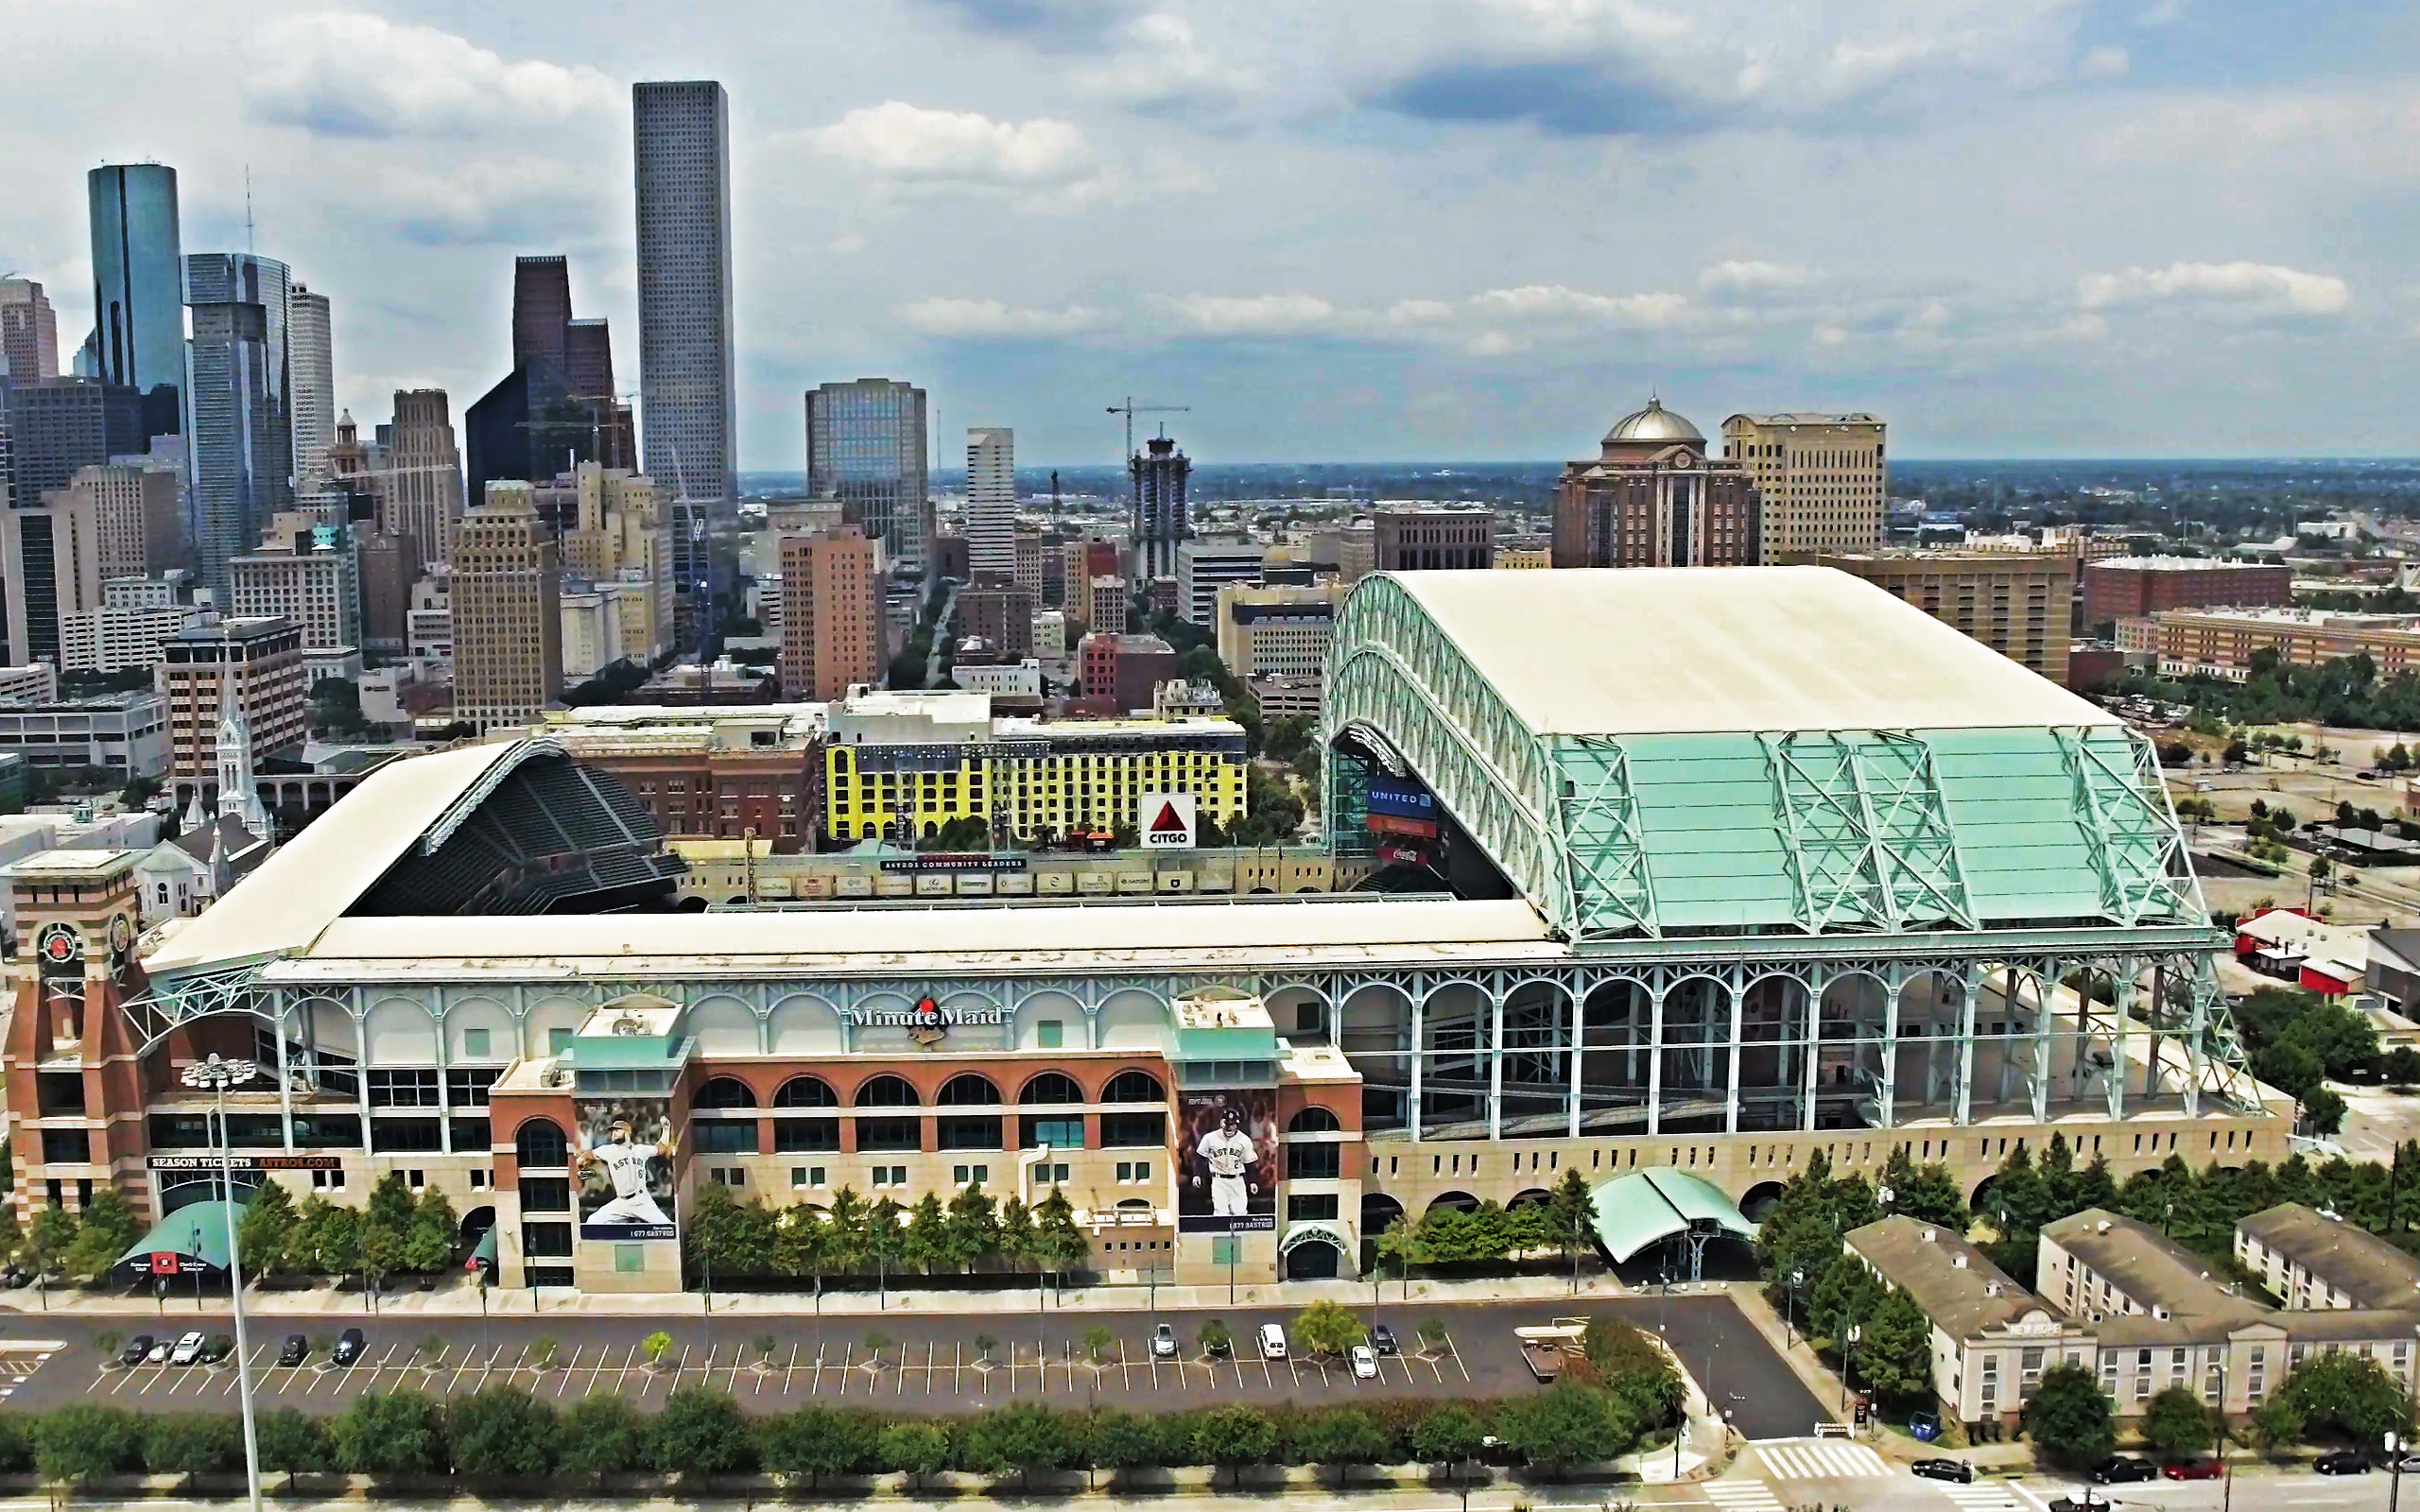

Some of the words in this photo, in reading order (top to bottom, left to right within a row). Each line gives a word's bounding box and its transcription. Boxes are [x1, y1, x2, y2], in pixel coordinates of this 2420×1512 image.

[1372, 790, 1417, 803] UNITED
[1149, 833, 1187, 844] CITGO
[850, 1007, 939, 1026] Minute
[939, 1005, 1003, 1025] Maid
[152, 1158, 198, 1168] SEASON
